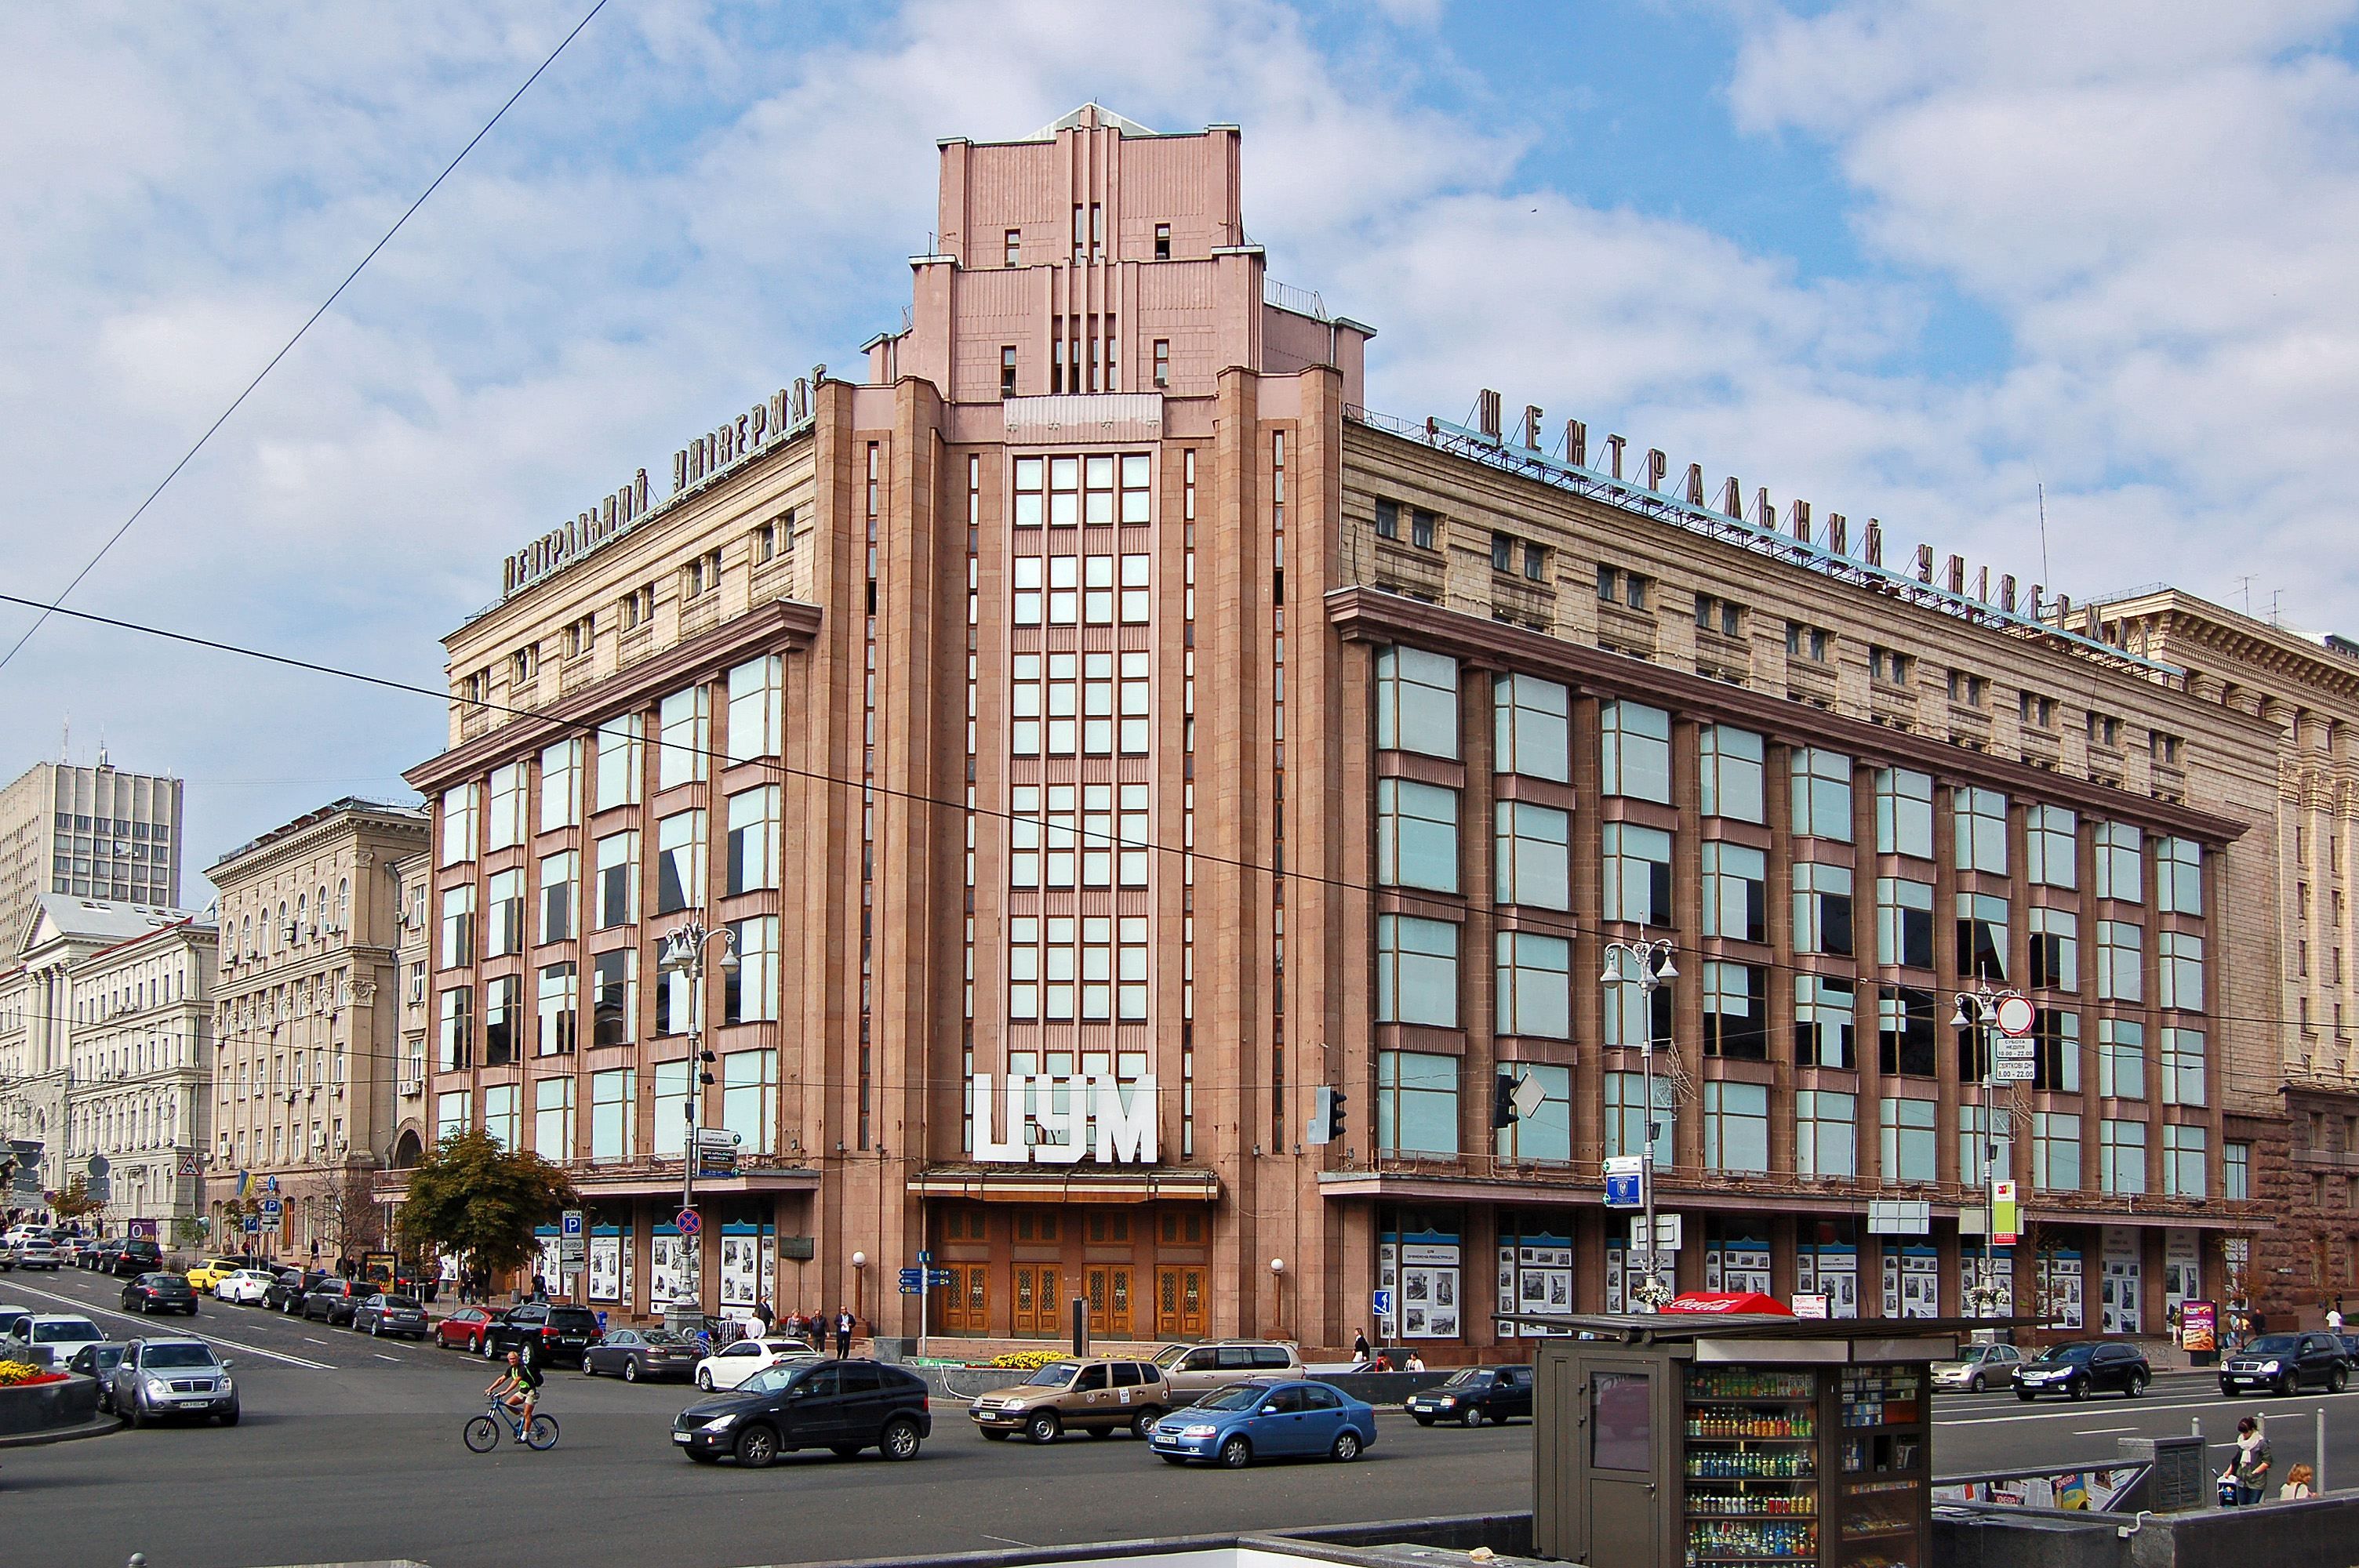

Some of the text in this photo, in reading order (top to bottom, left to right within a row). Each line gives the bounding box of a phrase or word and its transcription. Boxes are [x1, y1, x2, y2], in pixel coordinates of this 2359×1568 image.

[503, 468, 648, 596] ЦЕНТРАЛЬНИЙ
[1480, 388, 1882, 568] ЦЕНТРАЛЬНИЙ
[972, 1073, 1158, 1163] ЦУМ
